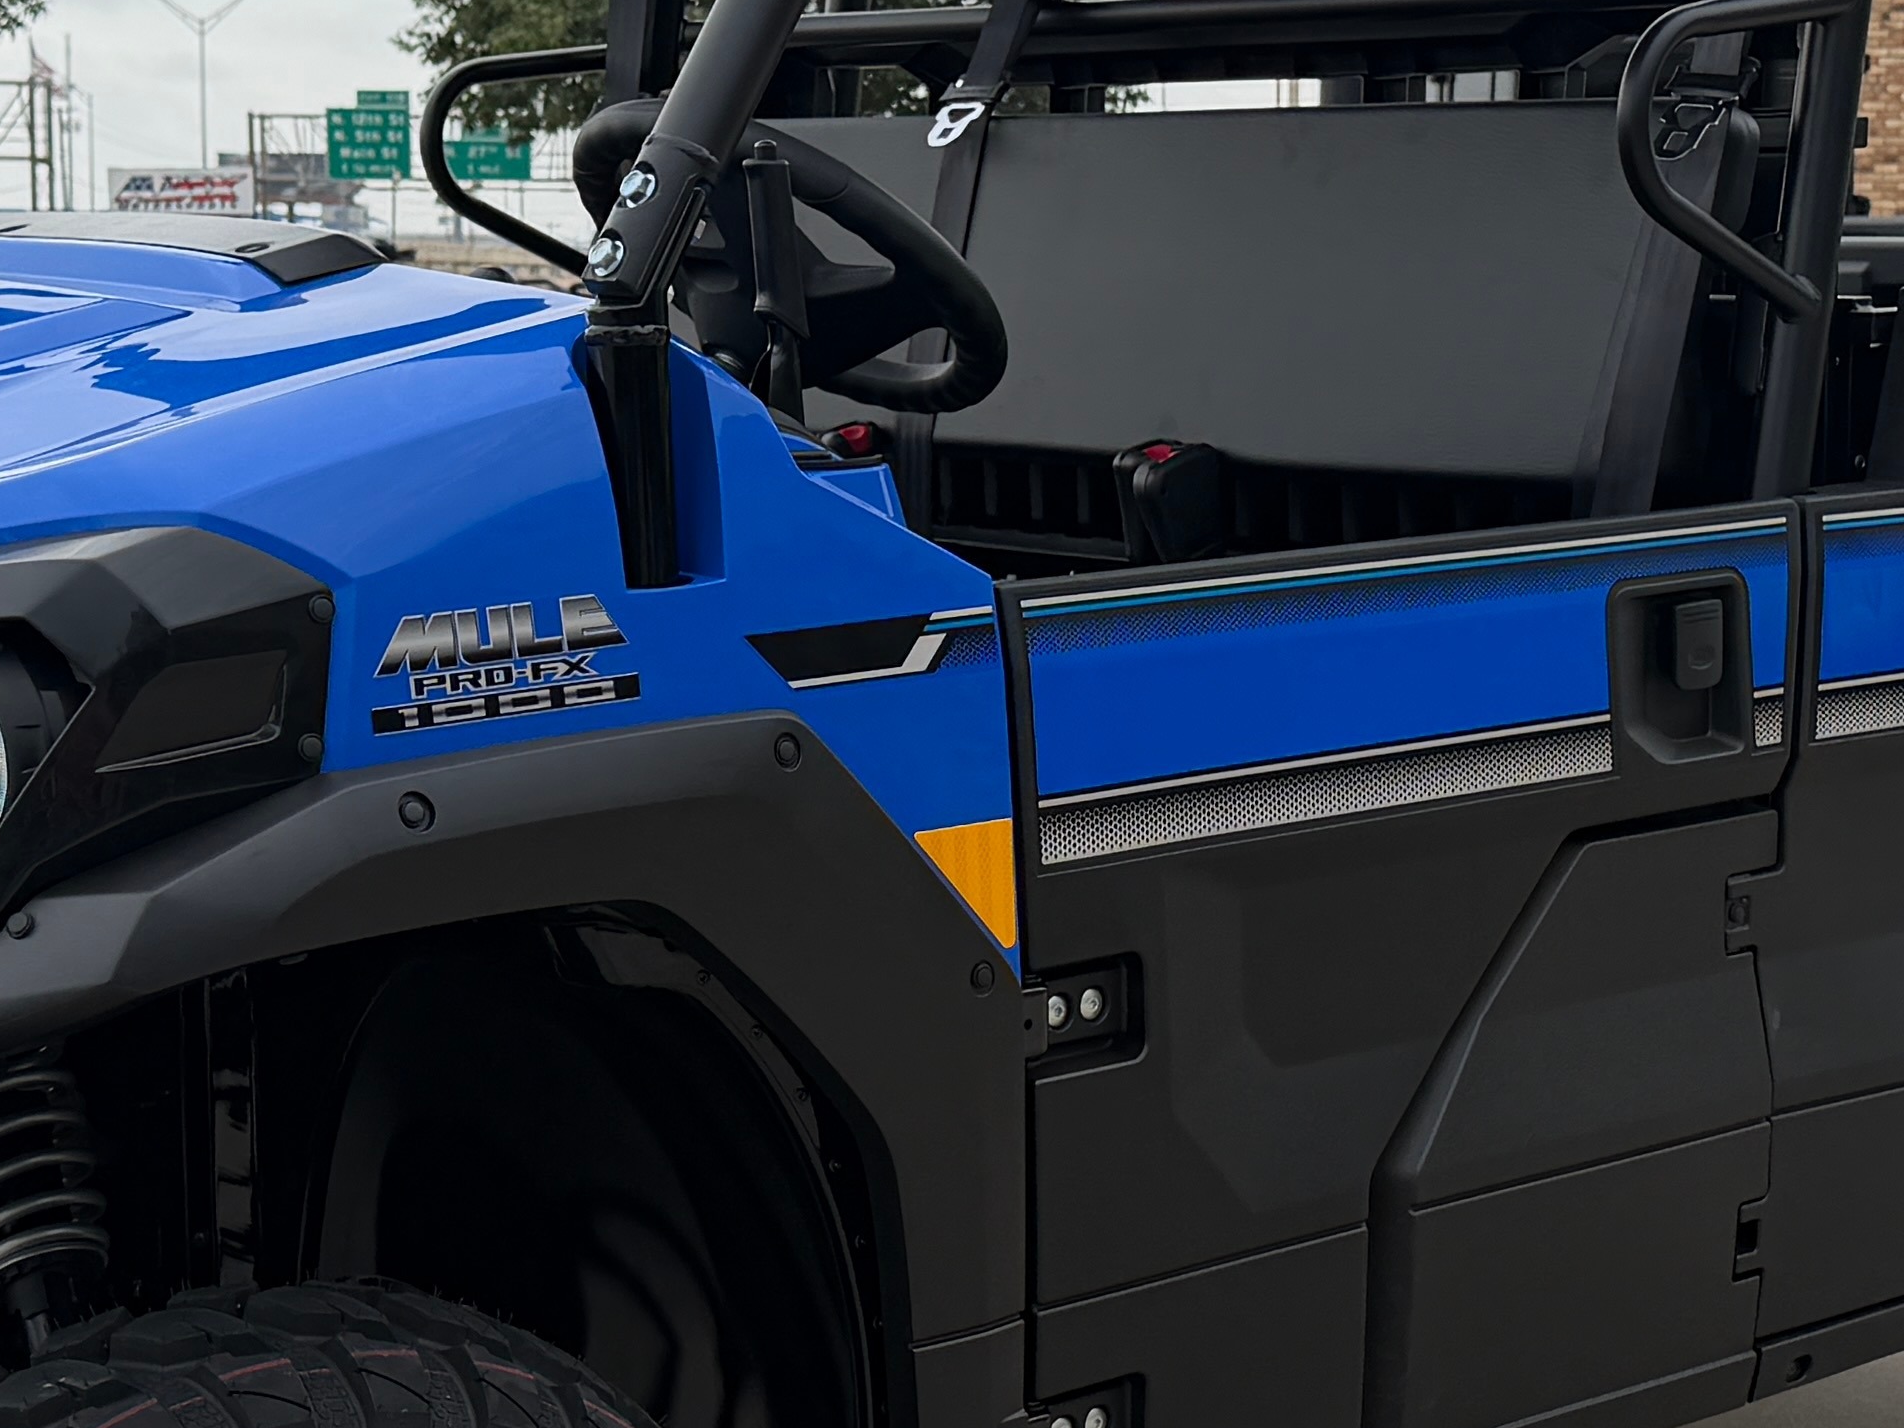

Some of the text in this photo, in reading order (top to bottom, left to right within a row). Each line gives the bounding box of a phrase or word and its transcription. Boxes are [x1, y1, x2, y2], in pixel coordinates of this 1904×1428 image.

[373, 593, 630, 678] MULE
[409, 651, 600, 700] PRO-FX
[398, 679, 617, 729] 1000
